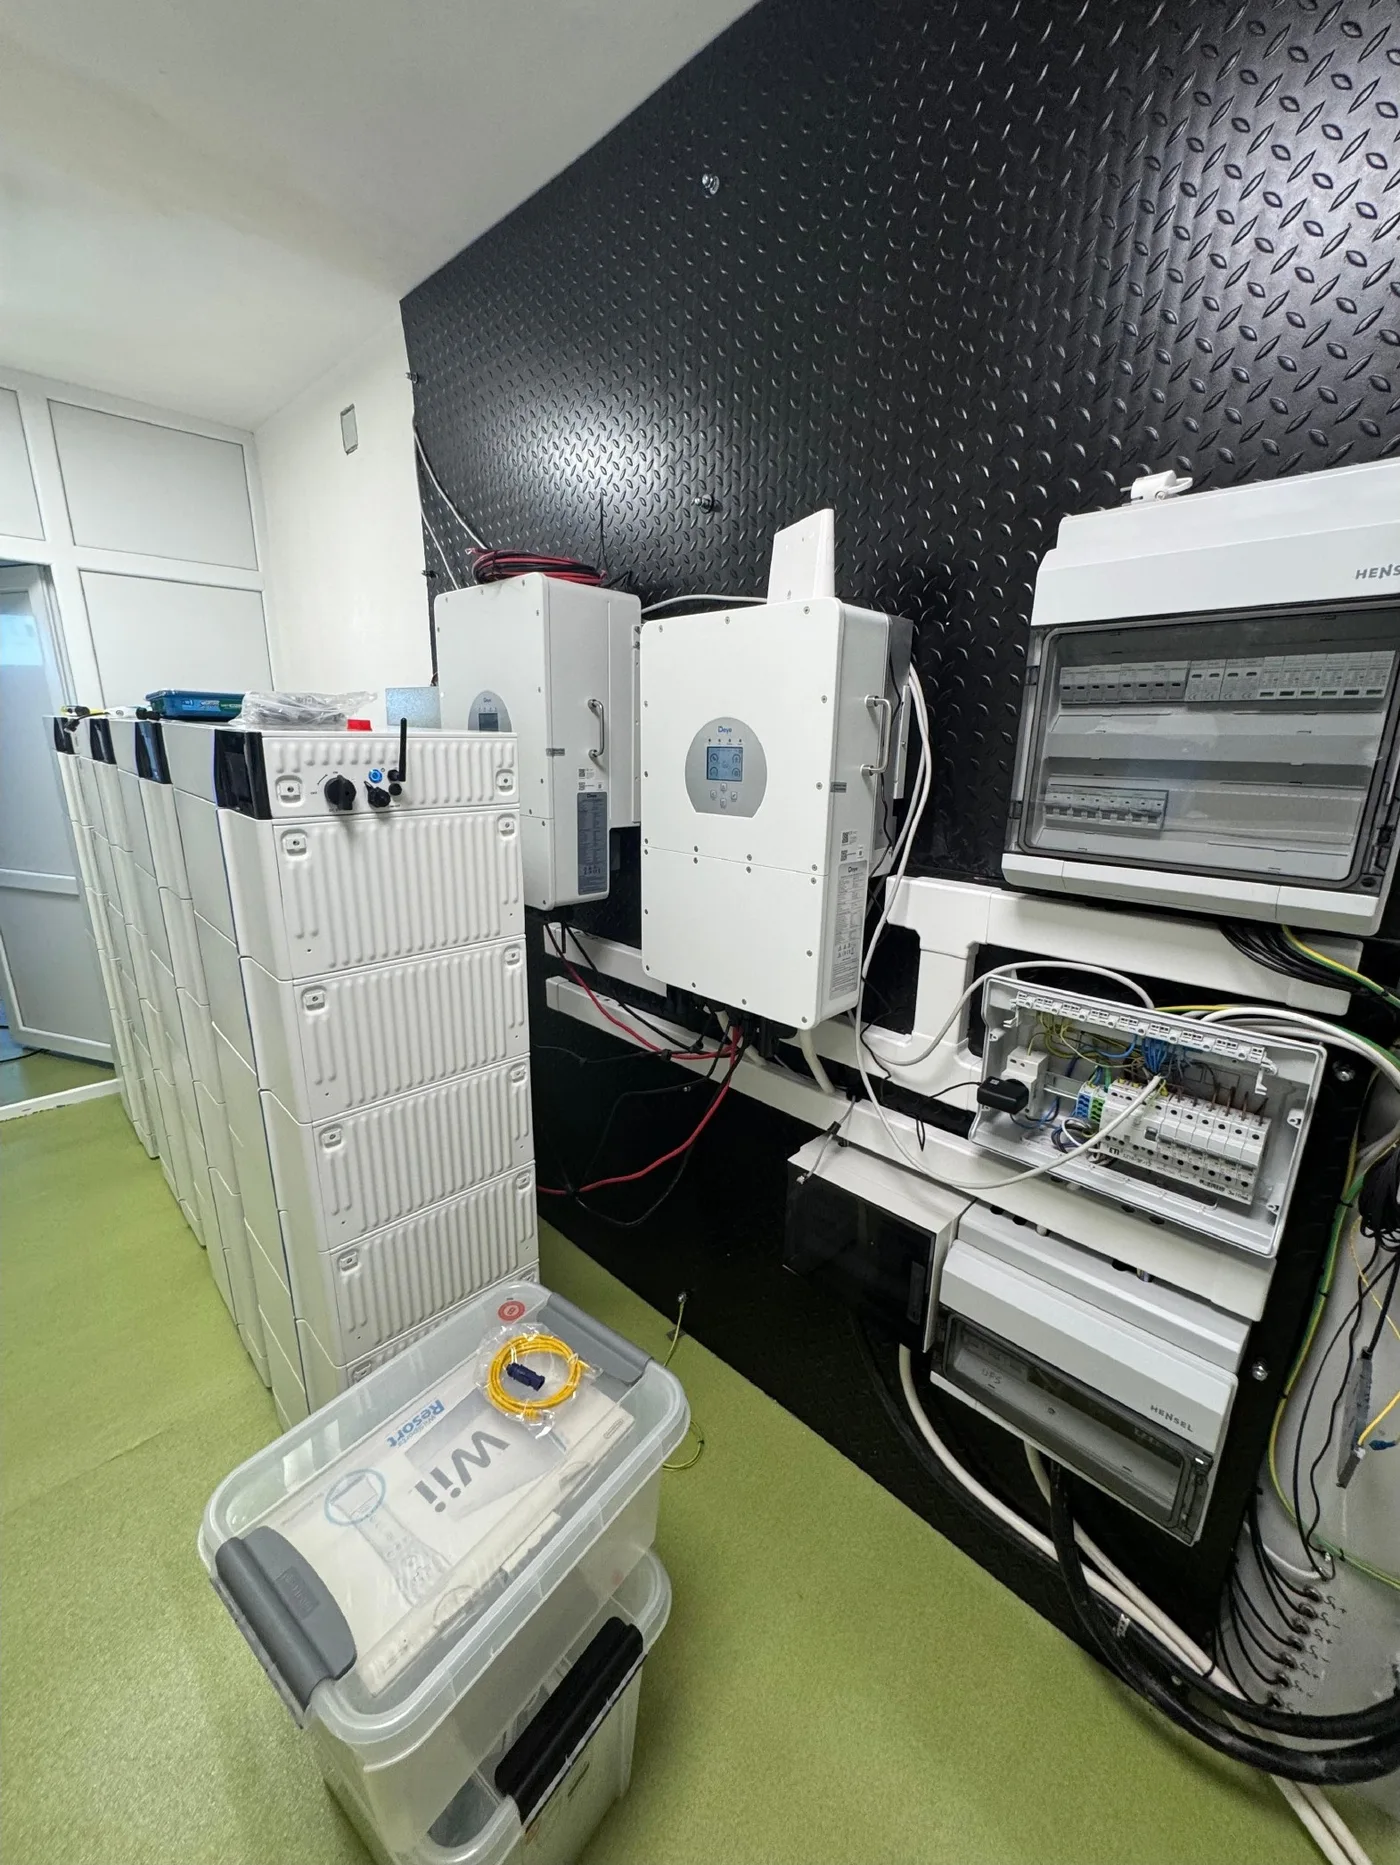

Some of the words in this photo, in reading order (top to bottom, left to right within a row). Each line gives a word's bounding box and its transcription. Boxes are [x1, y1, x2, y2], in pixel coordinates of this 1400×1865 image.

[1355, 563, 1400, 580] HENS
[718, 726, 732, 734] Deye
[387, 1399, 445, 1447] Resort
[1150, 1404, 1194, 1433] HENSEL
[414, 1431, 511, 1513] Wii
